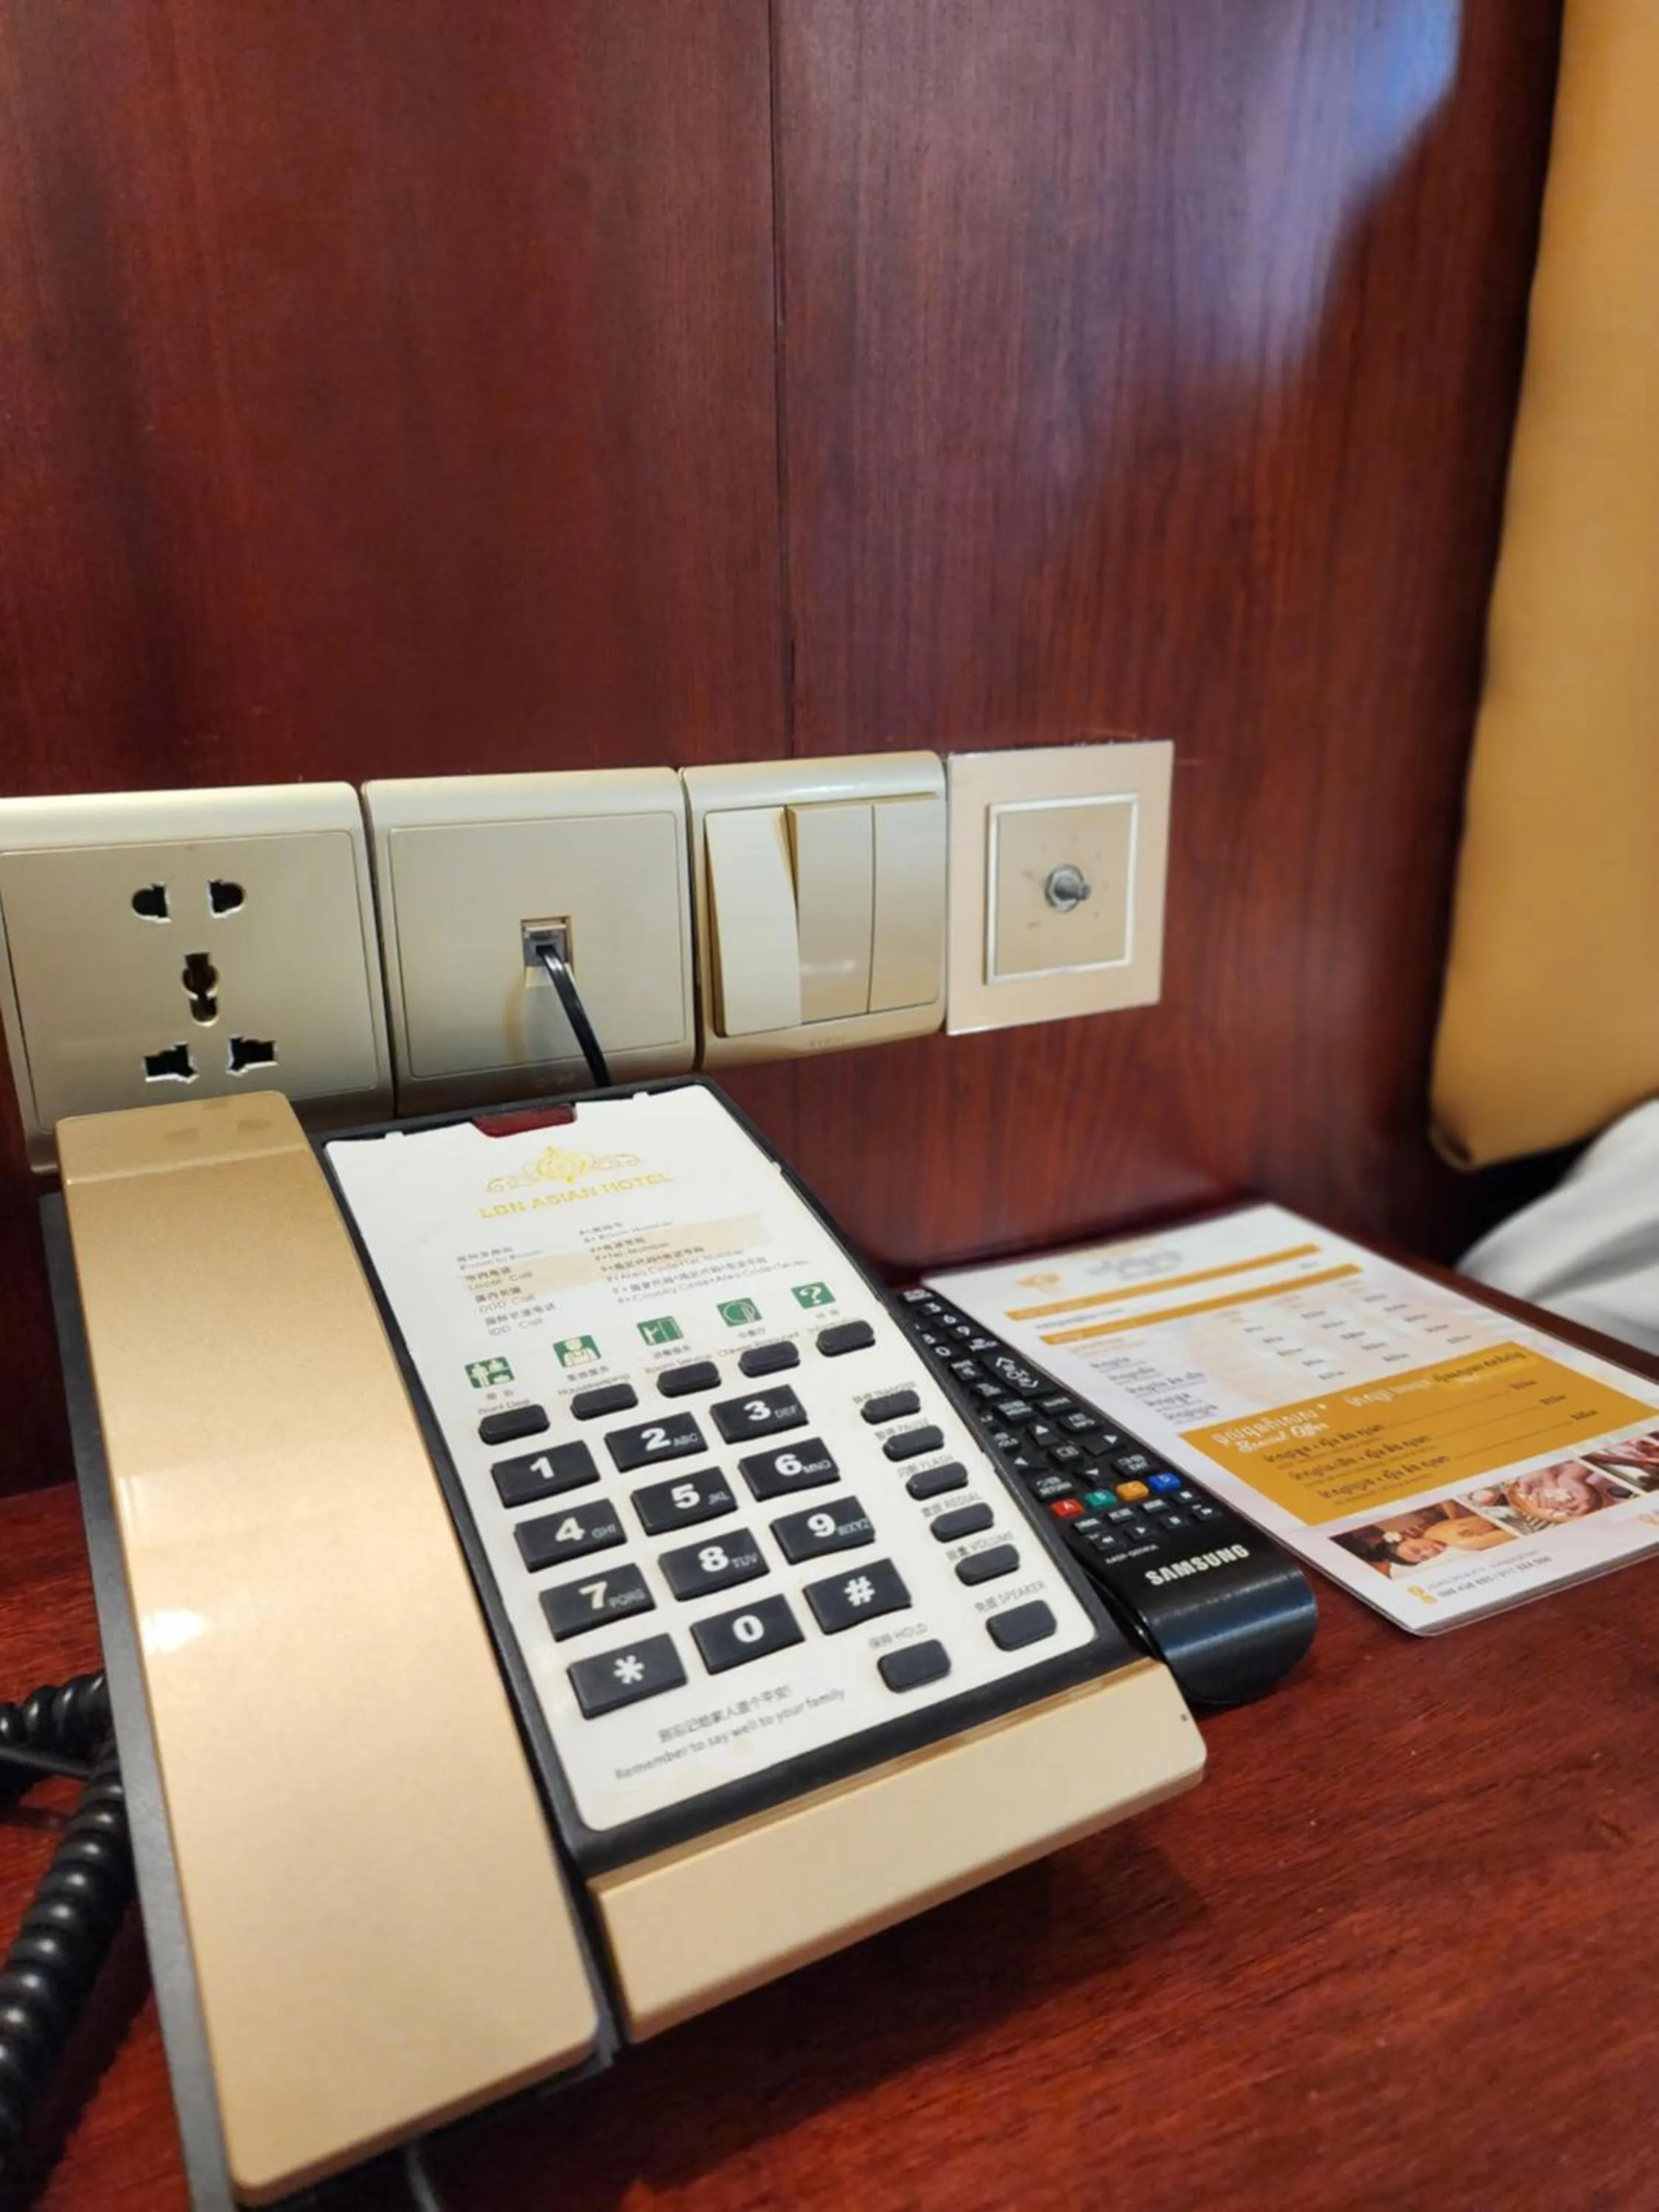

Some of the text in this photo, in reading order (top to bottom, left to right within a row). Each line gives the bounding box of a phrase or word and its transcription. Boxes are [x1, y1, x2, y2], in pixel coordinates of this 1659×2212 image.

[532, 1186, 597, 1210] ASIAN
[602, 1173, 672, 1194] HOTEL
[943, 1314, 957, 1324] 6
[956, 1325, 970, 1336] 9
[934, 1346, 951, 1357] 0
[744, 1400, 799, 1422] 3 DEF
[641, 1427, 699, 1451] 2 ABC
[531, 1457, 554, 1480] 1
[774, 1453, 832, 1476] 6 MNO
[671, 1484, 700, 1509] 5
[555, 1517, 617, 1543] 4 GHI
[807, 1512, 836, 1538] 9
[698, 1546, 759, 1572] 8 TUV
[1144, 1543, 1251, 1586] SAMSUNG
[579, 1582, 608, 1610] 7
[844, 1575, 875, 1607] #
[998, 1579, 1046, 1602] SPEAKER
[733, 1615, 764, 1643] 0
[893, 1622, 928, 1640] HOLD
[614, 1687, 846, 1780] Remember to say well to your family
